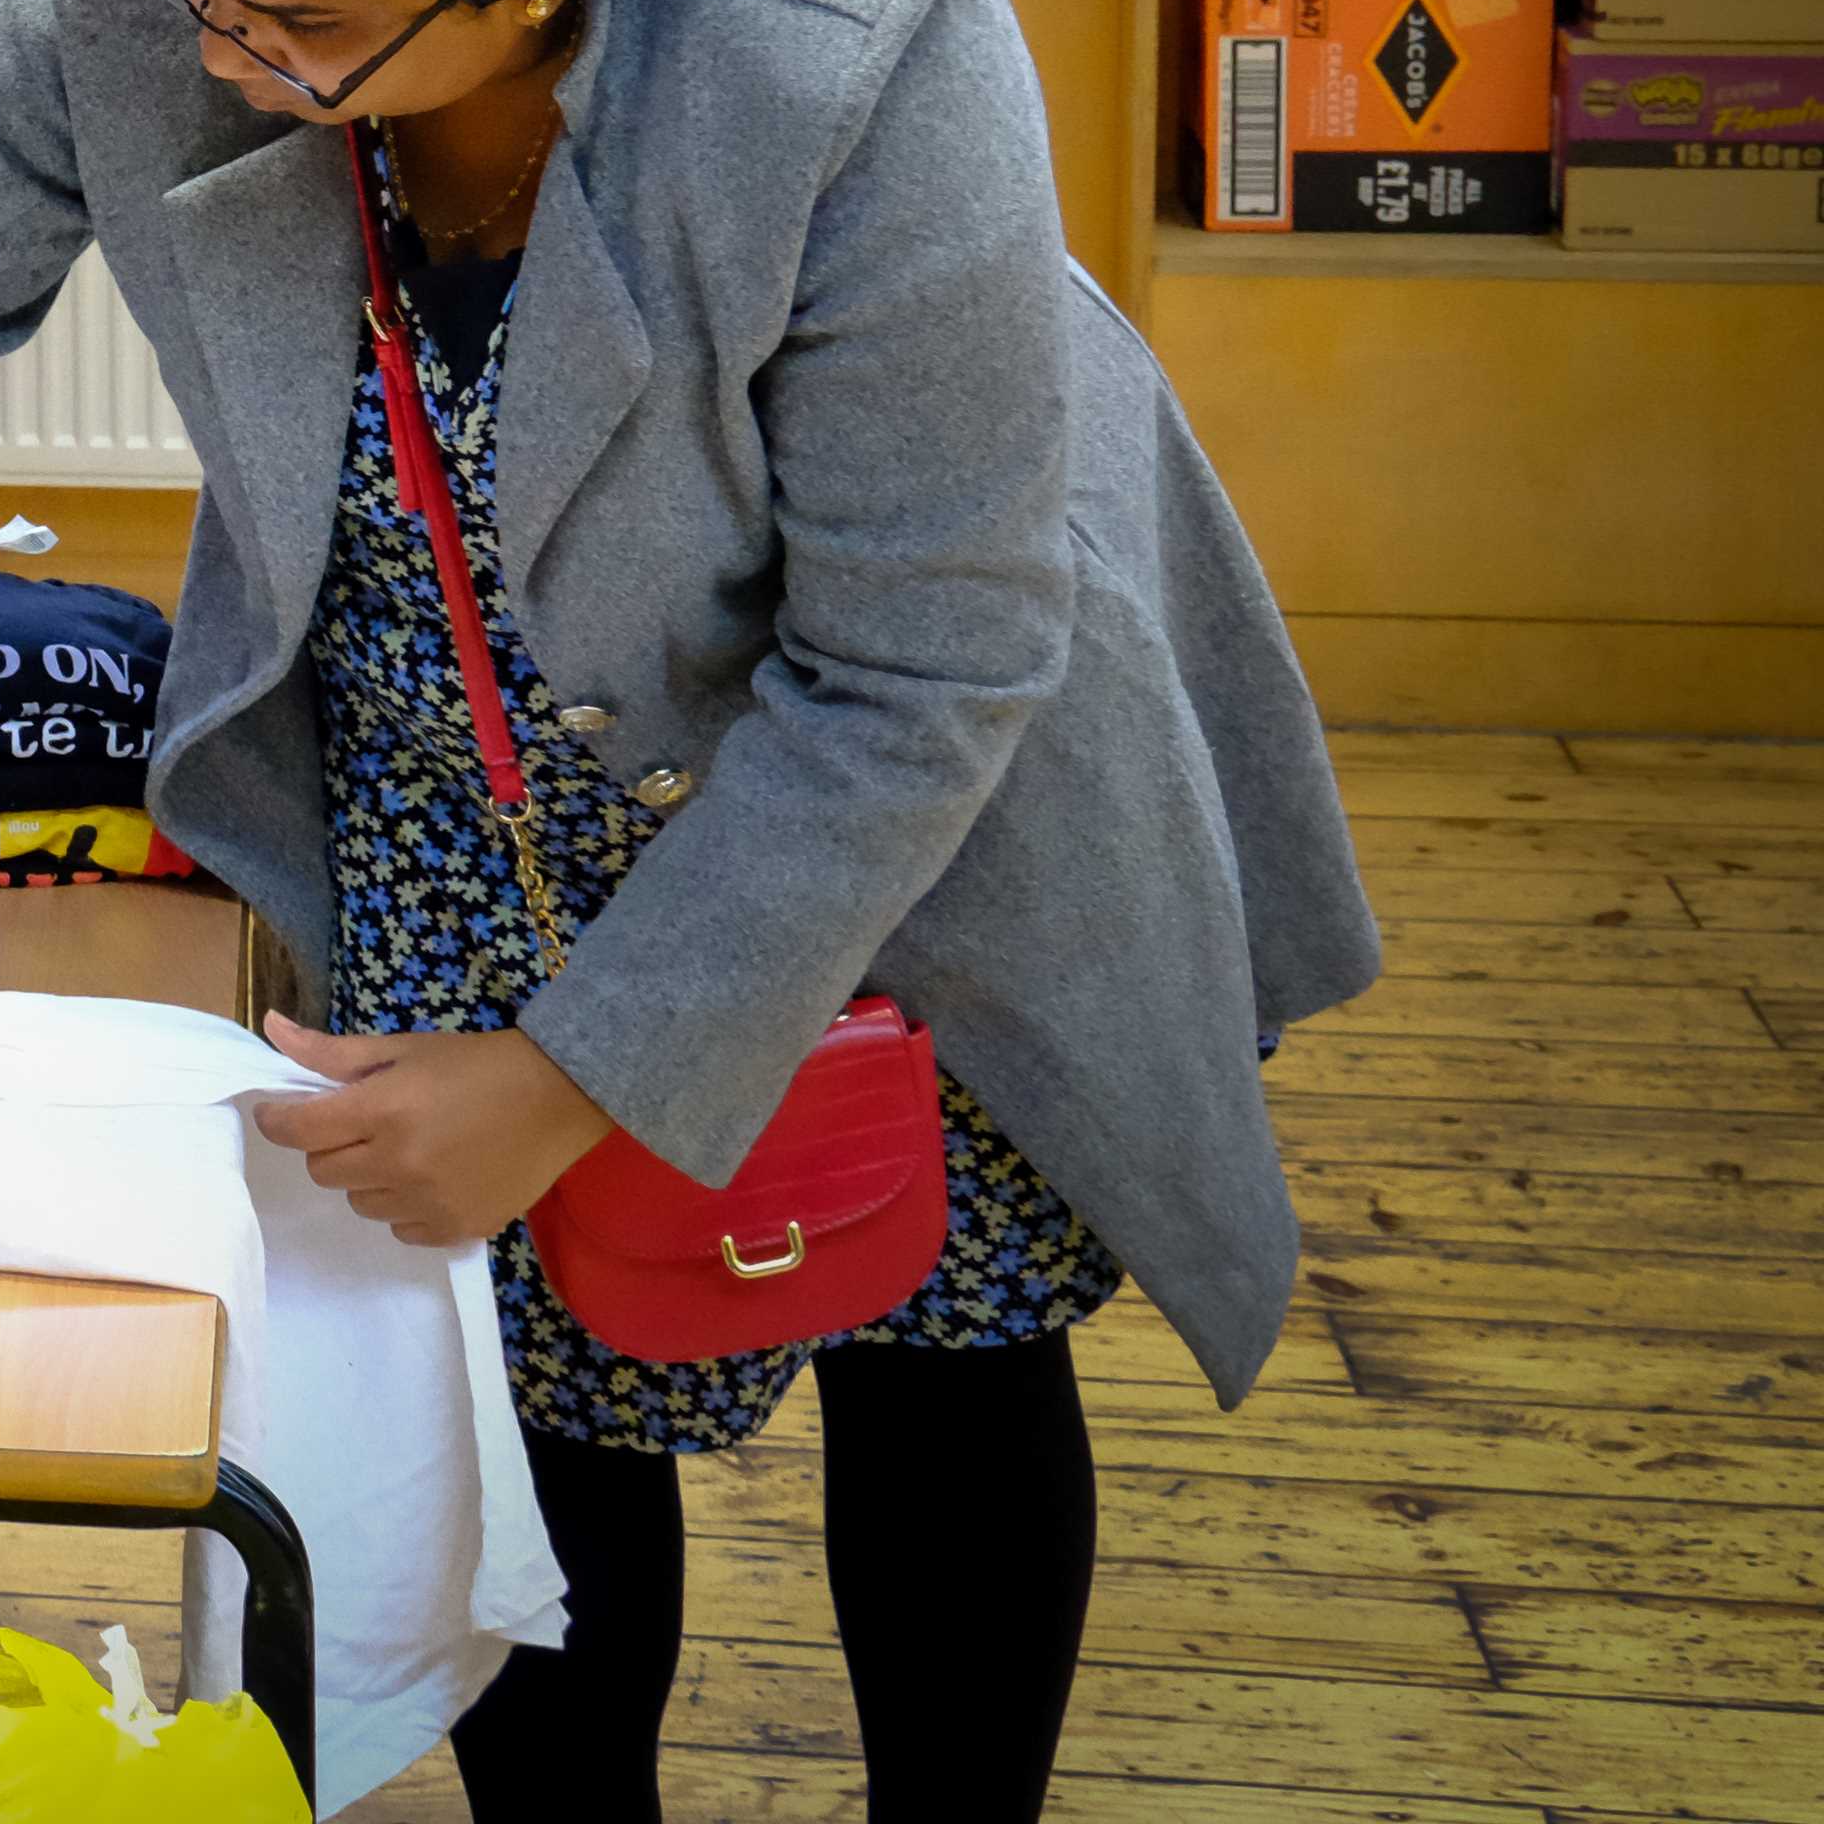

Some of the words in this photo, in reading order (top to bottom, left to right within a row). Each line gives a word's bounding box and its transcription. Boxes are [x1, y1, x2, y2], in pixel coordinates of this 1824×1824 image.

[1676, 143, 1706, 167] 15
[1377, 160, 1410, 224] £1.79
[40, 643, 146, 704] ON,
